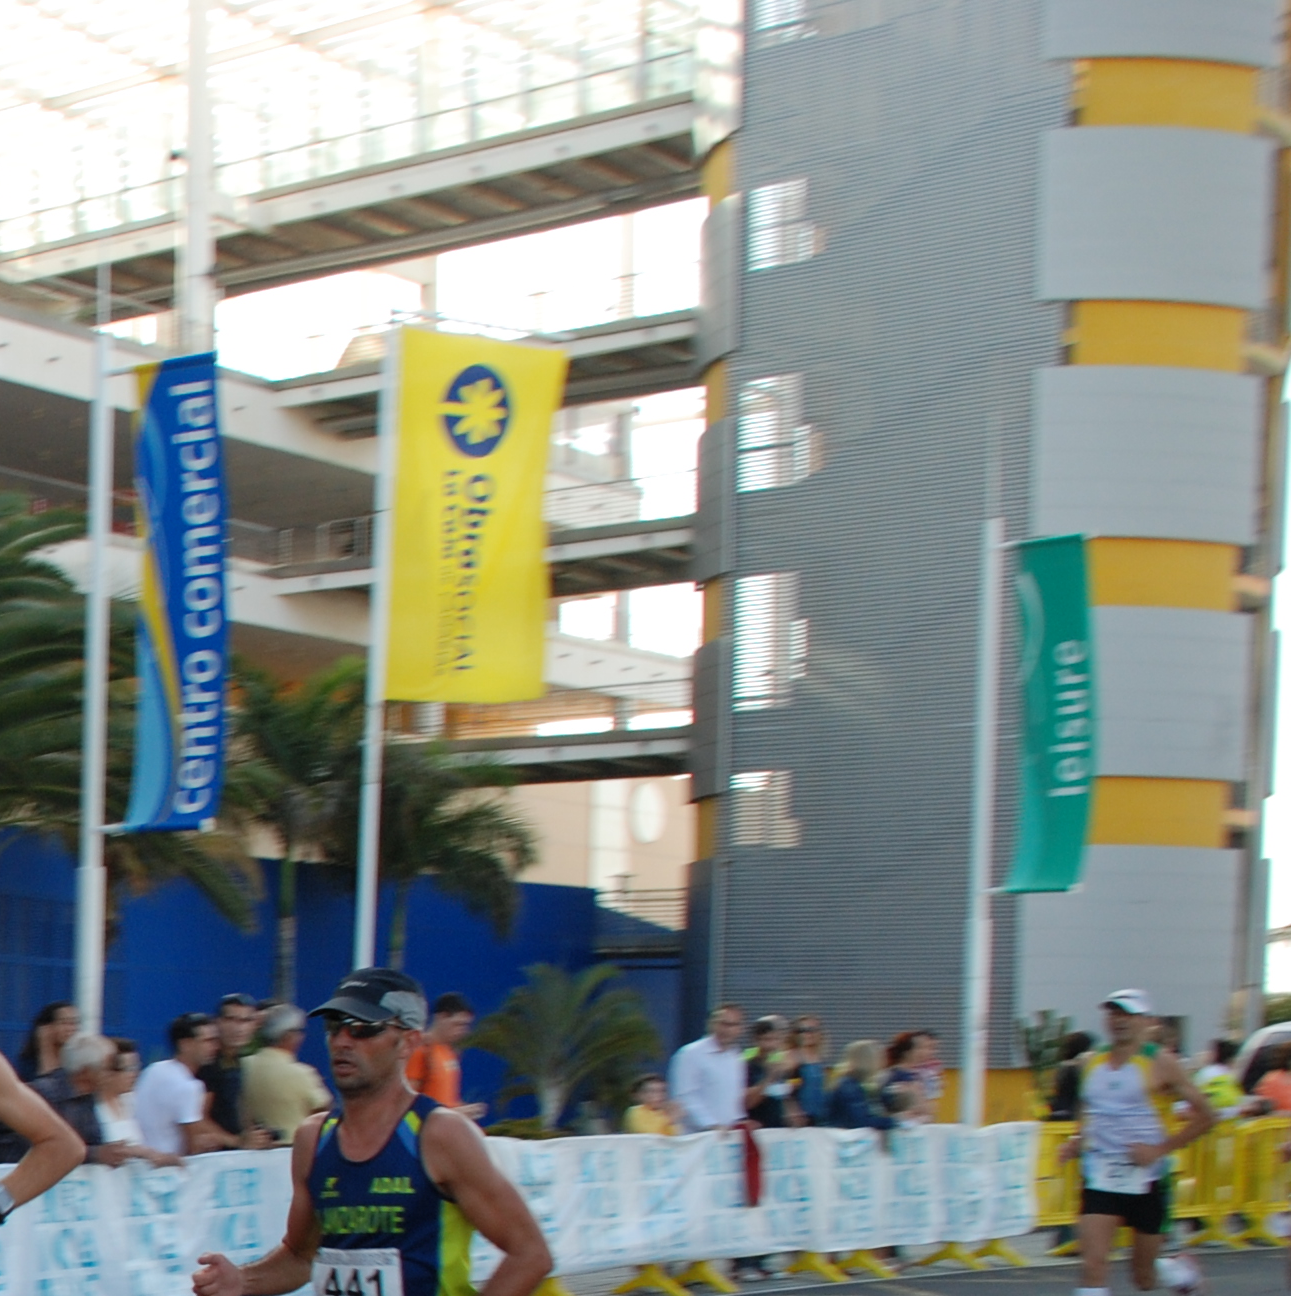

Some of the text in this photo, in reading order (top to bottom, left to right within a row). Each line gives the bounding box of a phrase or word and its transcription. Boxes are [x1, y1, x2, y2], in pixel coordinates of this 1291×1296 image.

[169, 379, 222, 815] centro comercial
[1047, 638, 1091, 797] leisure
